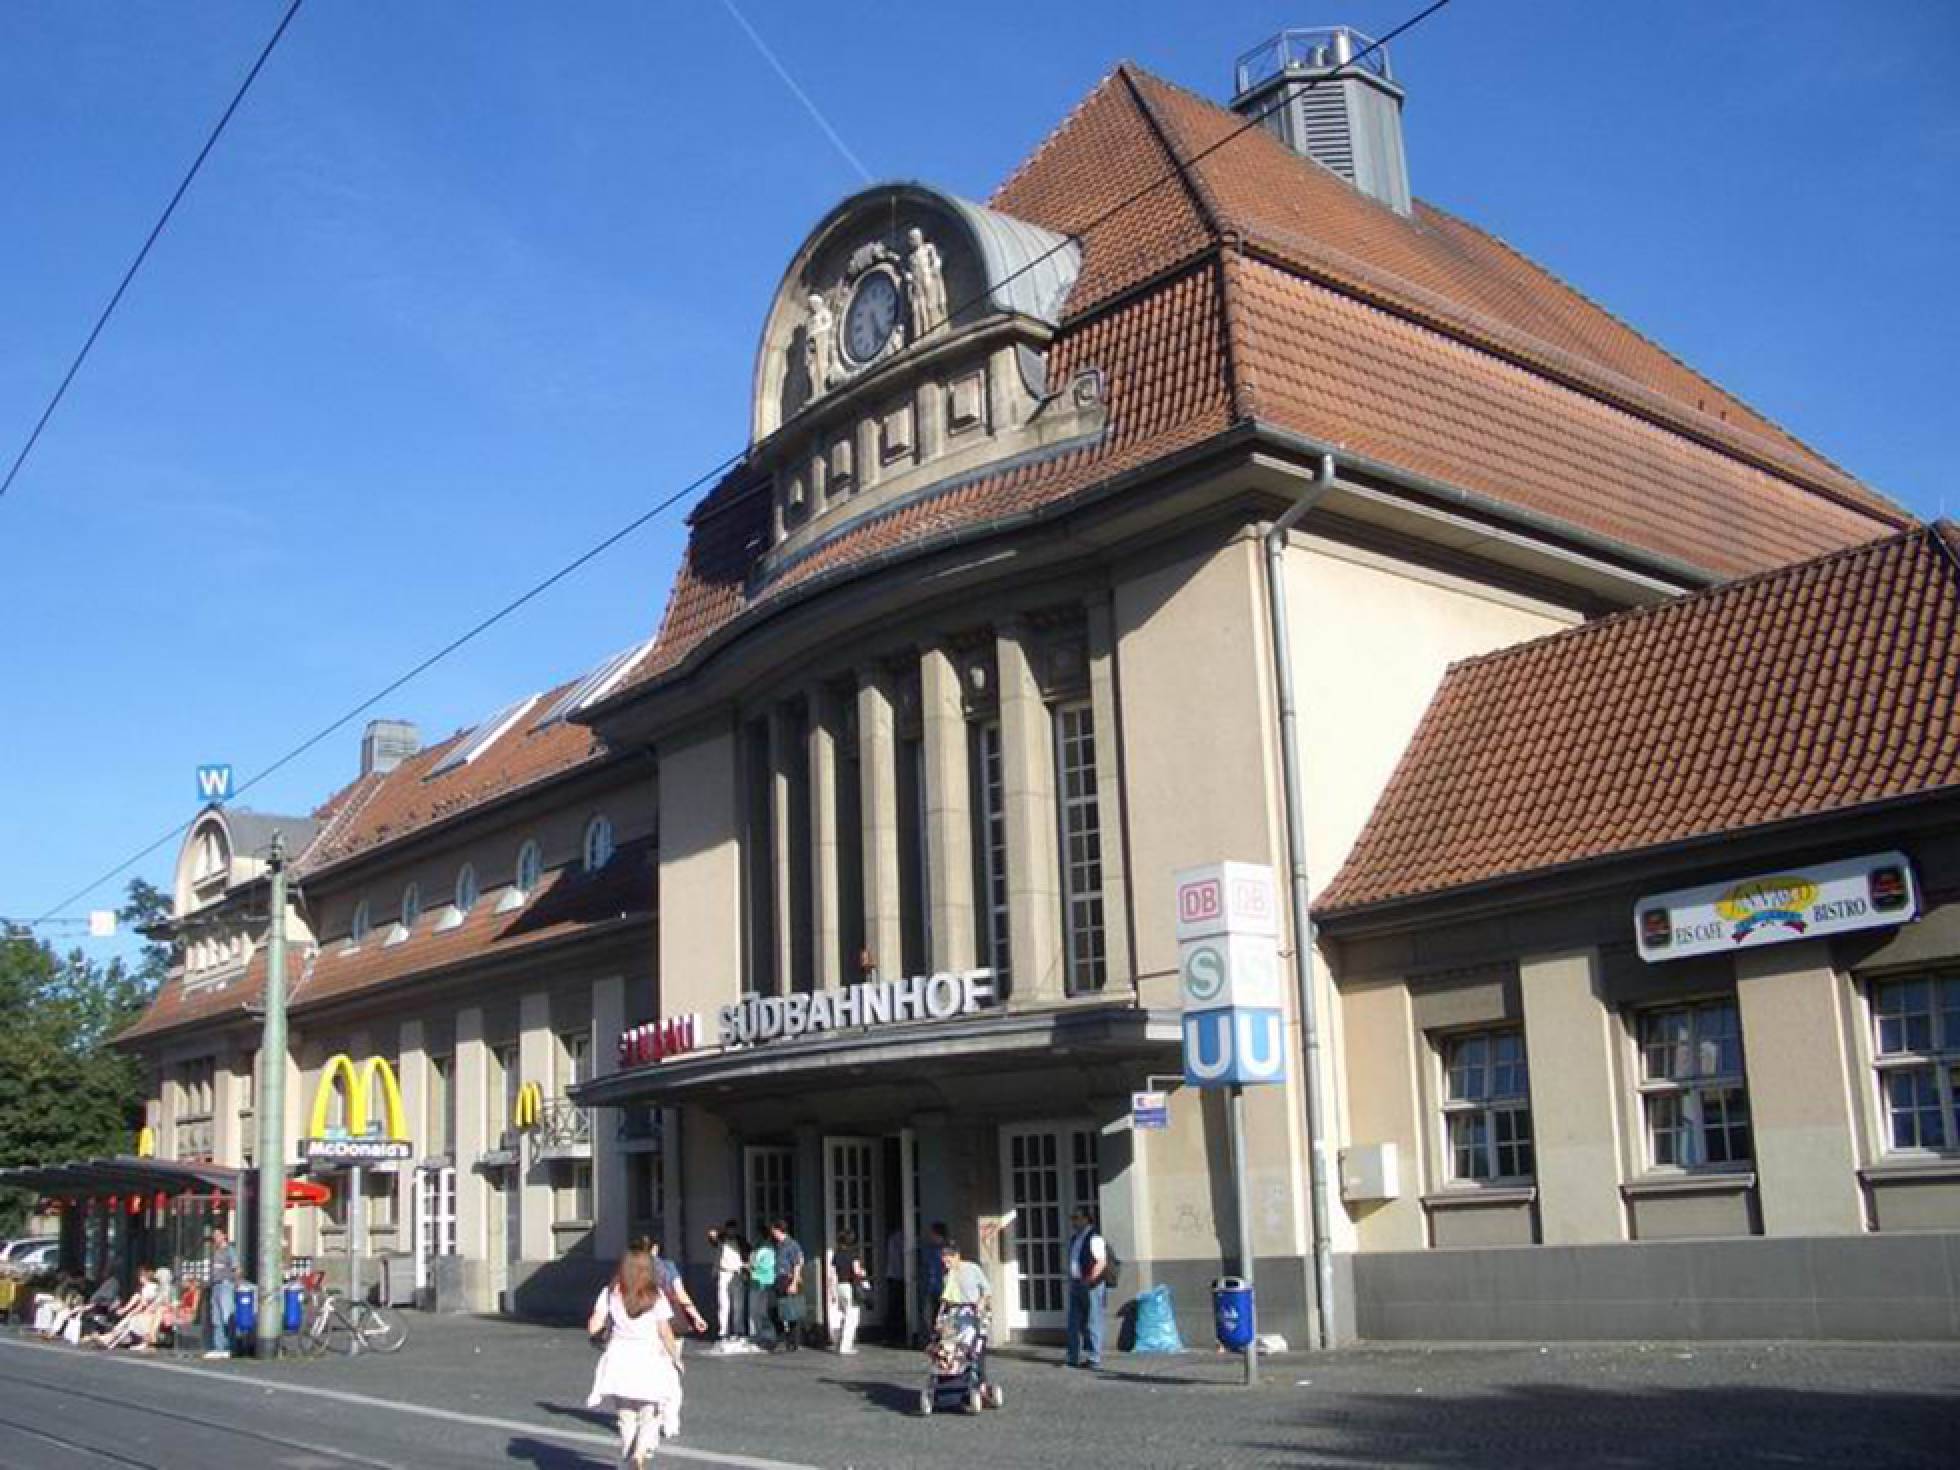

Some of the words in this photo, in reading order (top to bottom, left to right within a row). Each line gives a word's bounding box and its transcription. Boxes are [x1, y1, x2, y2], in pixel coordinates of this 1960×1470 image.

[199, 767, 229, 796] W
[1185, 887, 1217, 916] DB
[1813, 897, 1867, 923] BISTRO
[1190, 948, 1221, 997] S
[718, 967, 997, 1047] SÜDBAHNHOF
[1185, 1015, 1232, 1079] U
[1239, 1013, 1281, 1076] U
[308, 1141, 410, 1157] McDonald's
